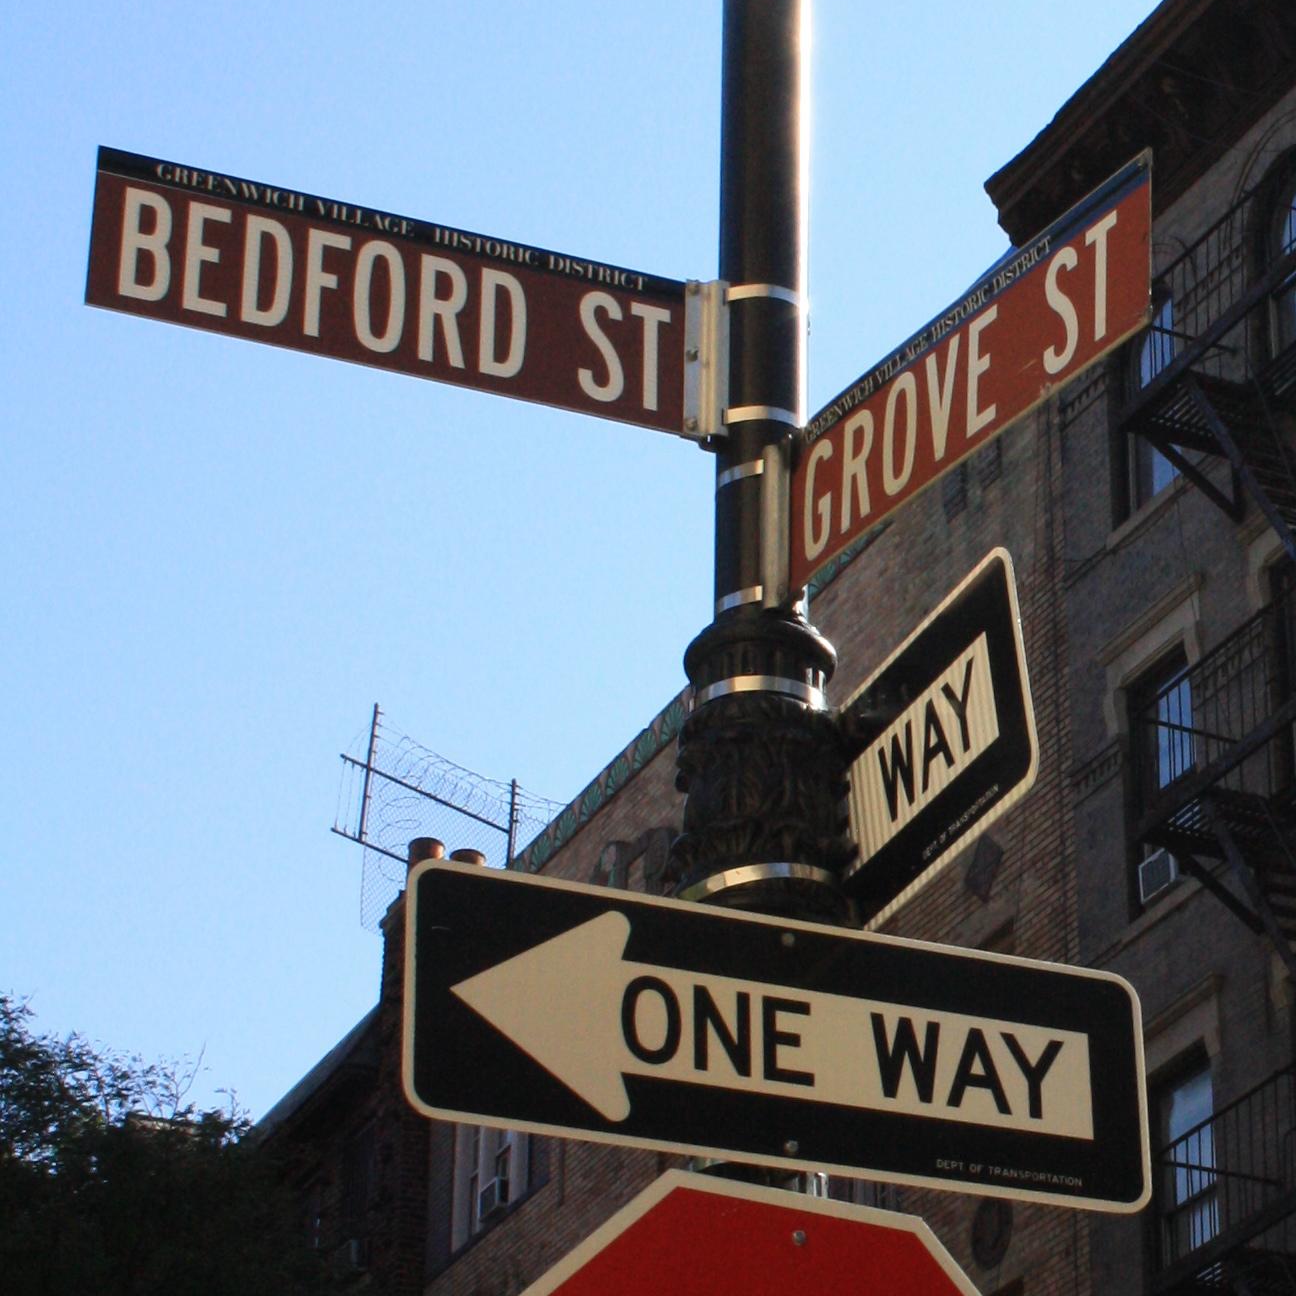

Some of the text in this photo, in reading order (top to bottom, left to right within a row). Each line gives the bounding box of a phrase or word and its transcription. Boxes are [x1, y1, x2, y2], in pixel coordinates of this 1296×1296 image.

[117, 185, 672, 412] BEDFORD ST
[156, 163, 649, 292] GREENWICH VILLAGE HISTORIC DISTRICT
[875, 334, 930, 383] VILLAGE
[931, 287, 992, 343] HISTORIC
[992, 234, 1053, 295] DISTRICT
[804, 209, 1118, 562] GROVE ST
[877, 656, 974, 823] WAY
[621, 975, 1064, 1120] ONE WAY
[935, 1158, 1085, 1188] DEPT OF TRANSPORTATION
